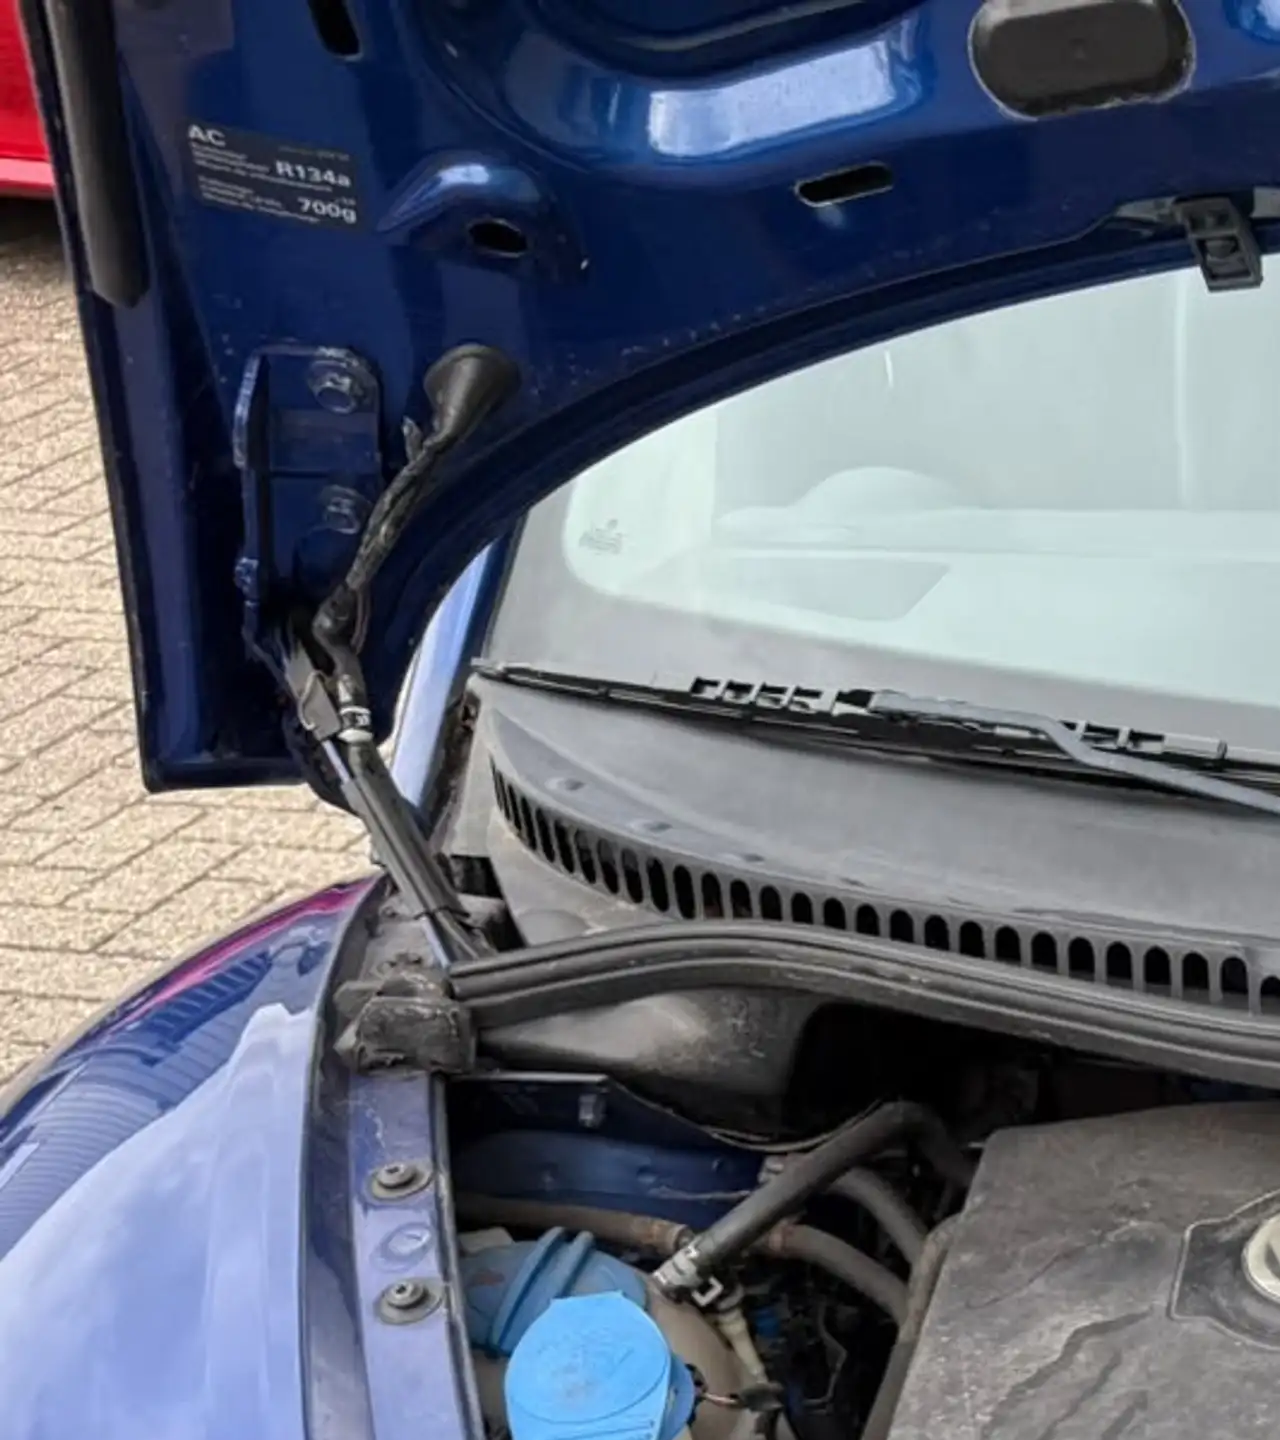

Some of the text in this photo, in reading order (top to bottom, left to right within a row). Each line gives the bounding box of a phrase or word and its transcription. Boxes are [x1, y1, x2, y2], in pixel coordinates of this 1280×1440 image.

[188, 124, 227, 147] AC
[275, 160, 351, 188] R134a
[297, 196, 357, 224] 700g
